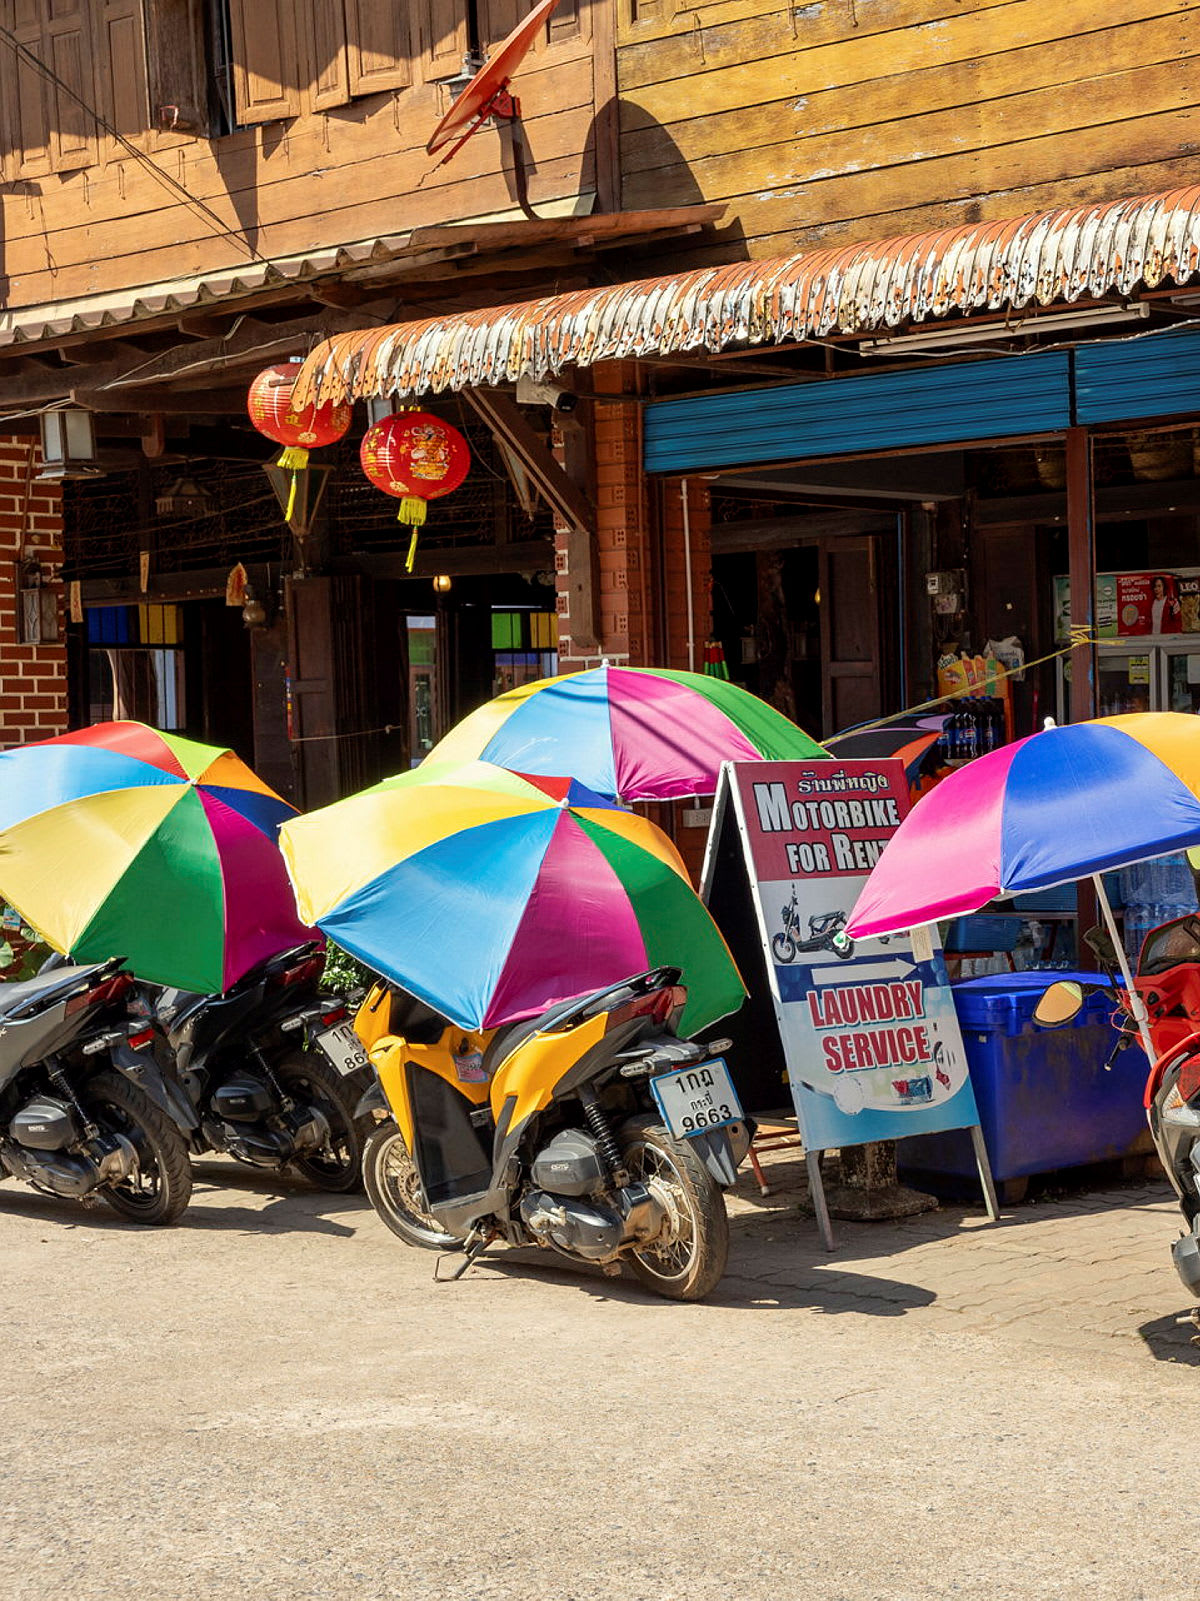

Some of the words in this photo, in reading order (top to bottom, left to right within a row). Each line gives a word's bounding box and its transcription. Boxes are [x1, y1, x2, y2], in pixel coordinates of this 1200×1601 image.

[1179, 582, 1199, 593] LEO
[798, 770, 890, 794] ร้านพี่หญิง
[753, 782, 901, 832] MOTORBIKE
[785, 843, 831, 874] FOR
[807, 981, 925, 1029] LAUNDRY
[822, 1025, 932, 1073] SERVICE
[690, 1090, 714, 1111] กระบี่
[681, 1104, 732, 1133] 9663
